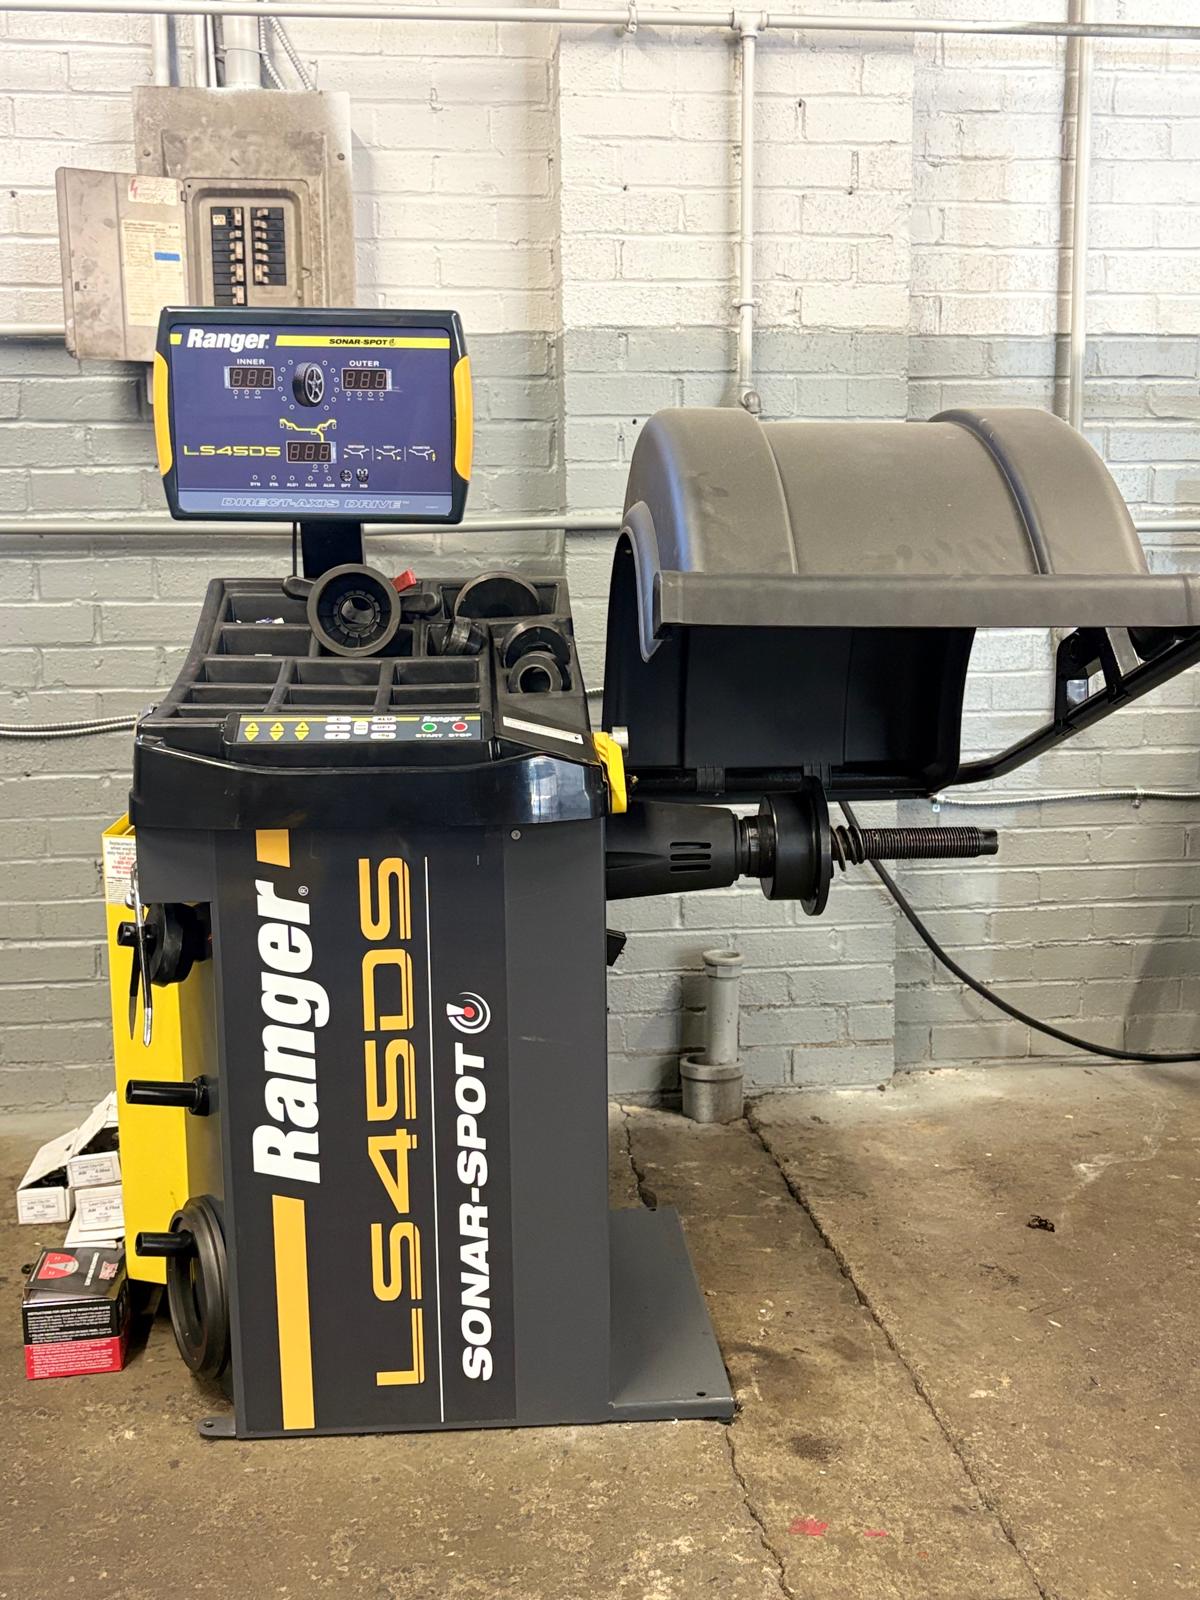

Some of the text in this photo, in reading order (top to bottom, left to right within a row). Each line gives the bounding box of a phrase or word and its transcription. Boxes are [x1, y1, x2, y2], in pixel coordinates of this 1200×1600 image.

[329, 338, 387, 346] SONAR-SPOT
[357, 857, 425, 1386] LS45DS
[453, 1042, 493, 1382] SONAR-SPOT
